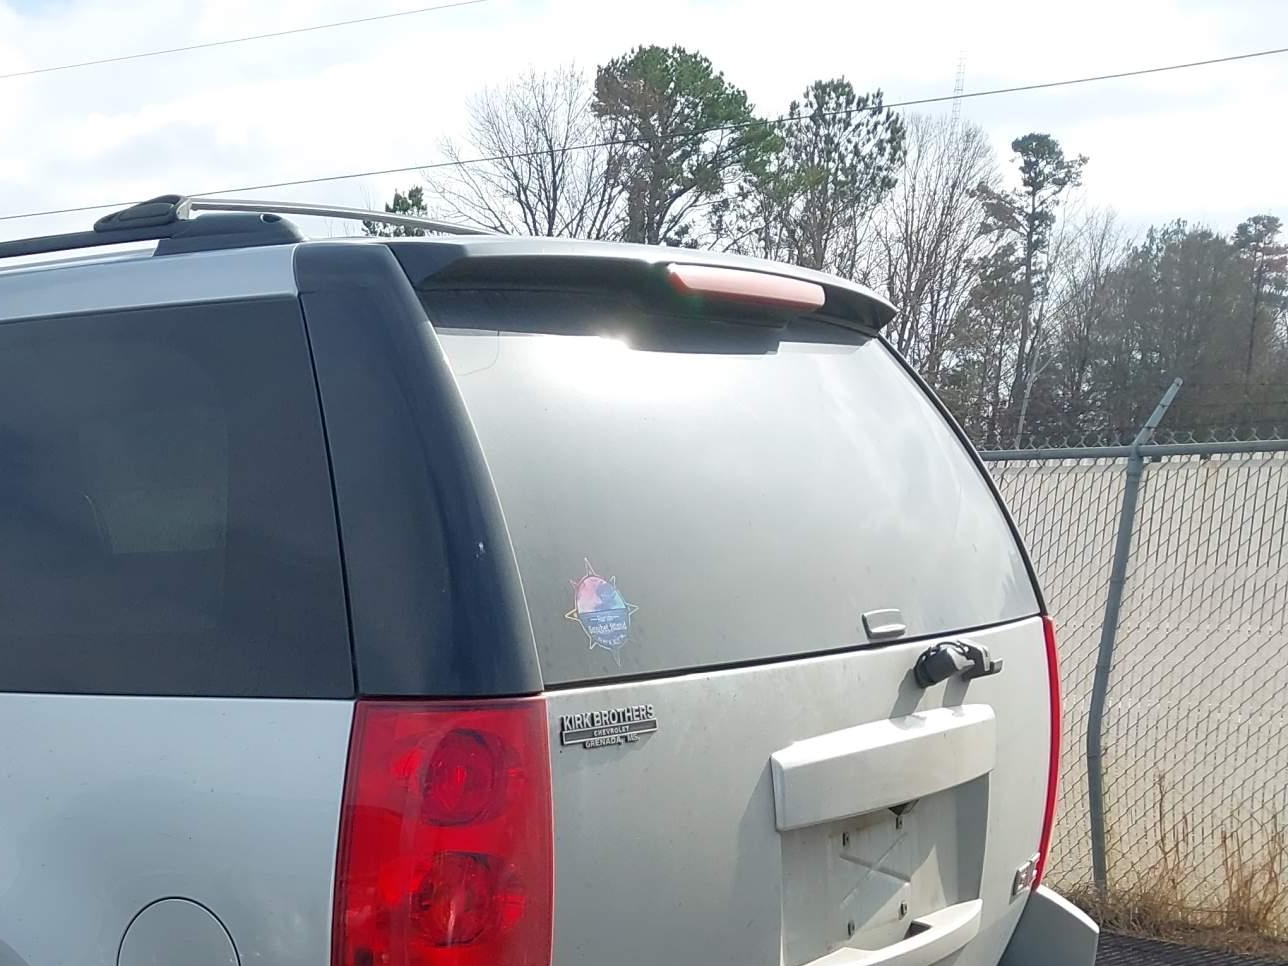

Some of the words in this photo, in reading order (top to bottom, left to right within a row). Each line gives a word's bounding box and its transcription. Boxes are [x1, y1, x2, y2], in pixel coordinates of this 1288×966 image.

[561, 712, 592, 731] KIRK
[593, 704, 655, 726] BROTHERS
[593, 725, 630, 737] CHEVROLET
